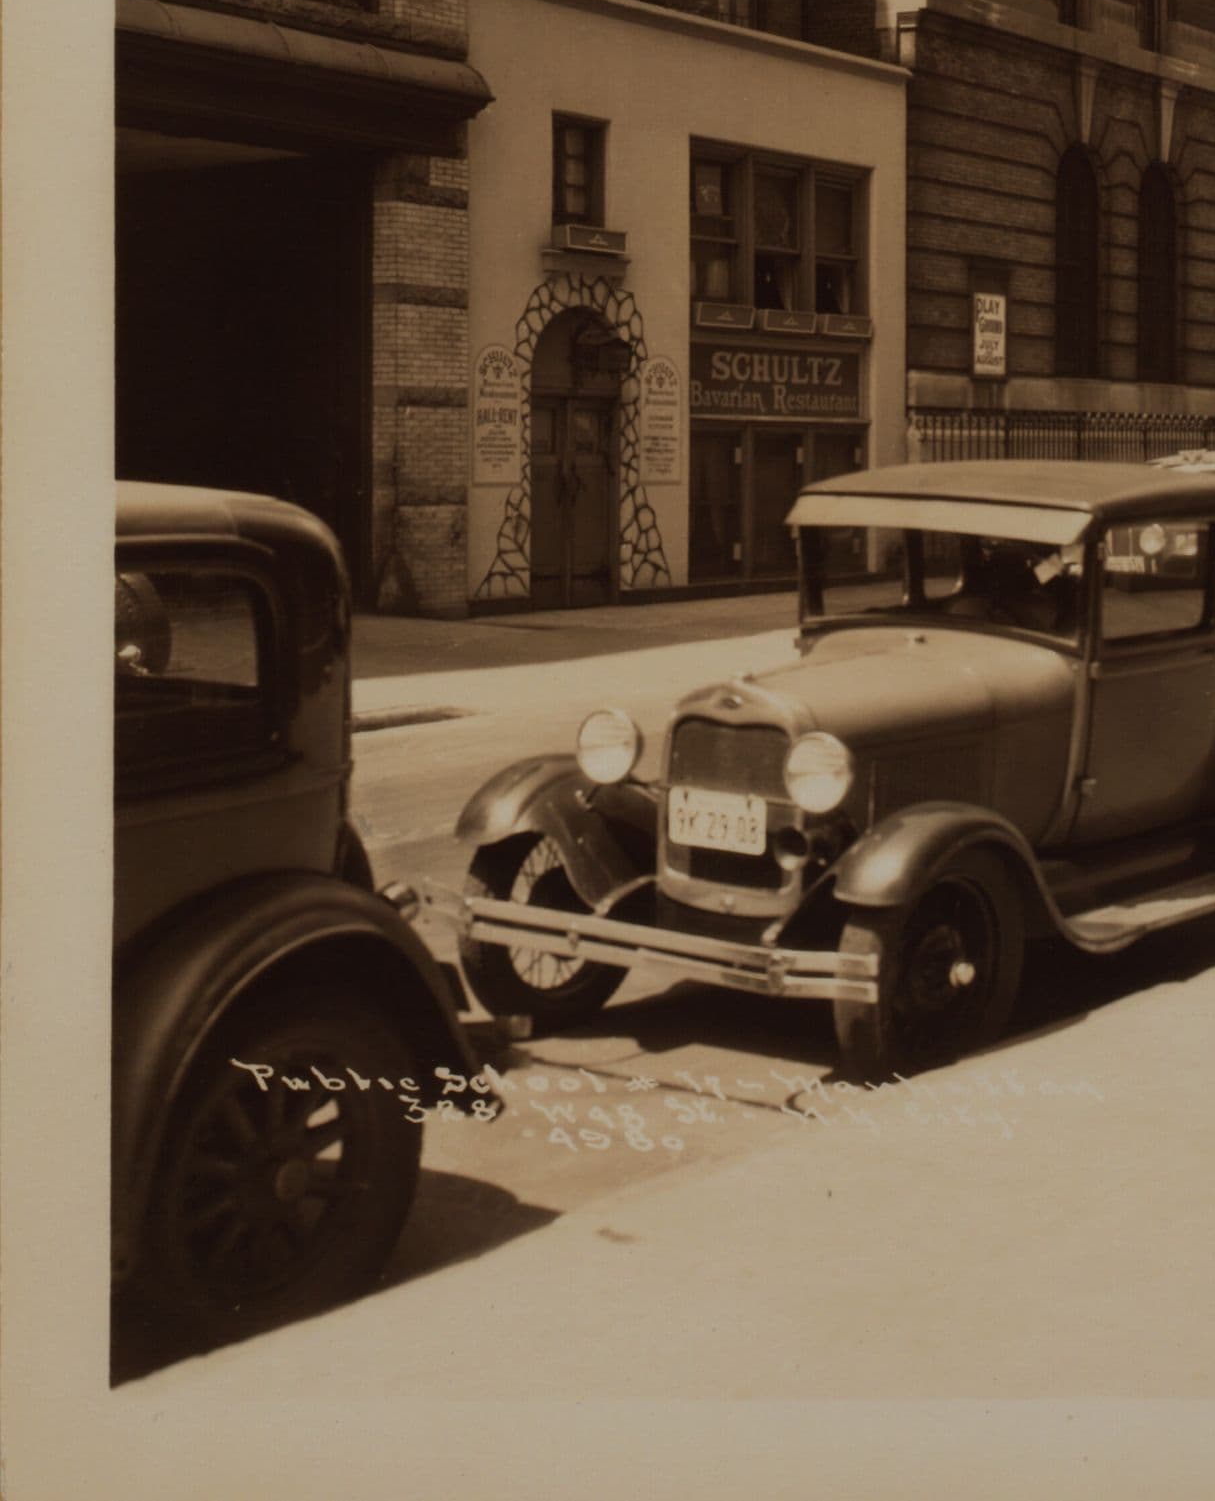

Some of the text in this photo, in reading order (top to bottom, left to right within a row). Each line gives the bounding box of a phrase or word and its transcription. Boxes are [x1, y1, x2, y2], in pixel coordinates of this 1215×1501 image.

[976, 297, 1000, 320] PLAY
[711, 351, 842, 386] SCHULTZ
[690, 380, 858, 414] Bavarian Restaurant
